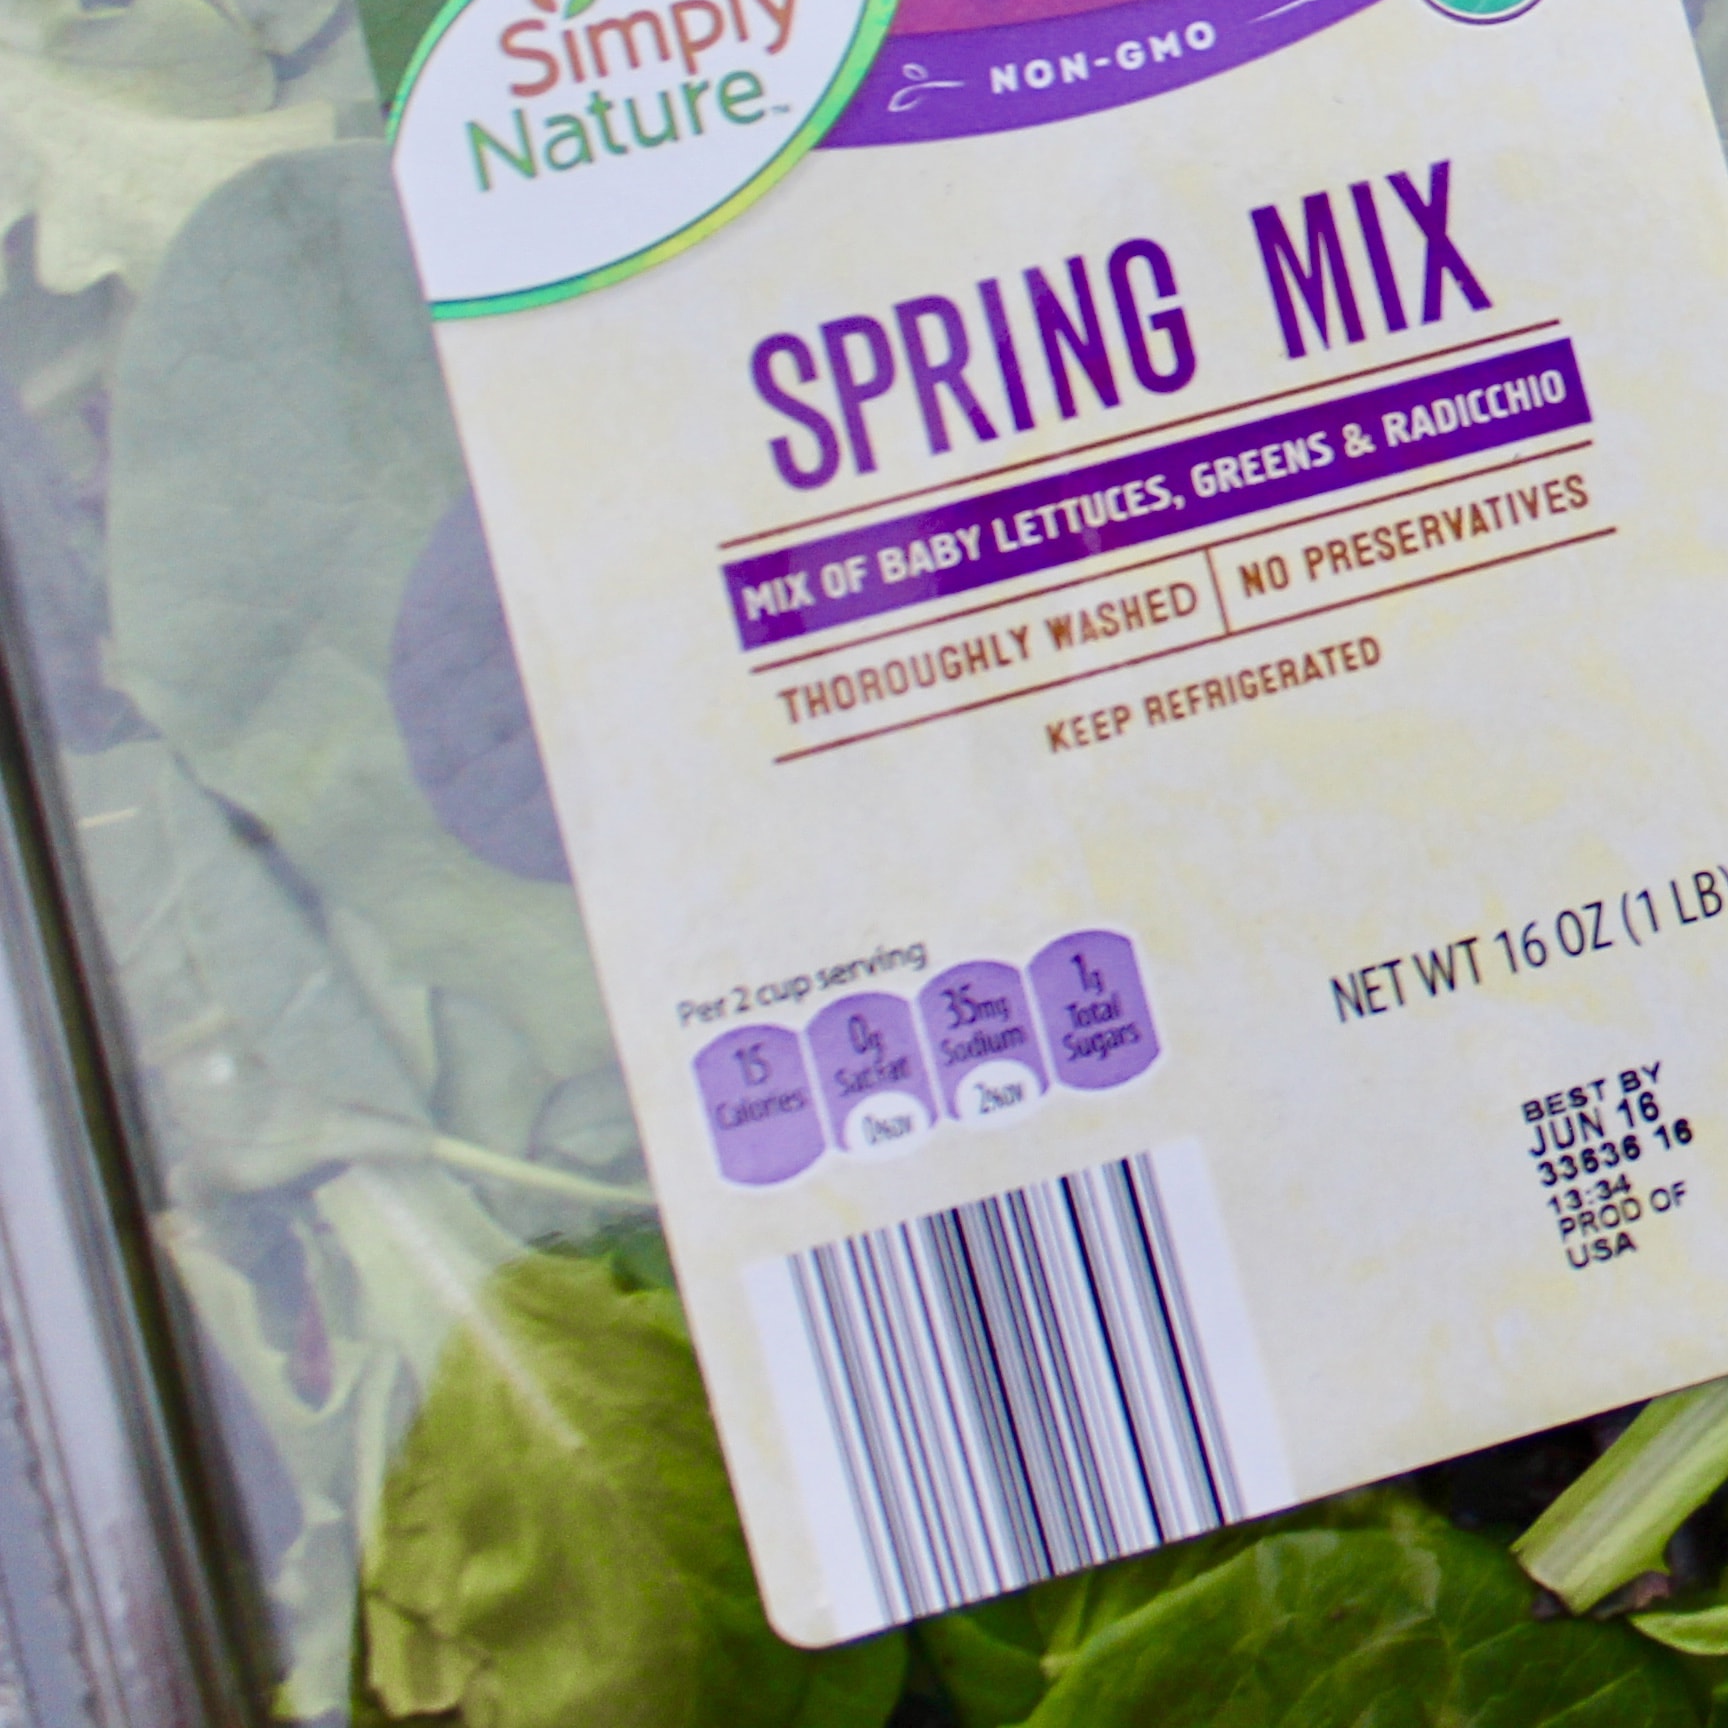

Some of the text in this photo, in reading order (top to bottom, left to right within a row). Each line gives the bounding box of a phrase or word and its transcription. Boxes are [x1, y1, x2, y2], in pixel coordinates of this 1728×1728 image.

[989, 20, 1217, 96] NON-GMO
[750, 159, 1492, 492] SPRING MIX
[742, 368, 1566, 622] MIX OF BABY LETTUCES, GREENS & RADICCHIO
[1237, 474, 1590, 598] NO PRESERVATIVES
[779, 581, 1198, 727] THOROUGHLY WASHED
[1045, 635, 1383, 755] KEEP REFRIGERATED
[676, 941, 929, 1029] Per 2 cup serving
[1329, 958, 1407, 1023] NET
[1412, 937, 1483, 998] WT
[1494, 922, 1548, 974] 16
[1555, 901, 1614, 957] OZ
[1620, 889, 1660, 947] (1
[1063, 1023, 1142, 1061] Sugars
[1065, 991, 1122, 1028] Total
[733, 1042, 770, 1085] 15
[941, 1026, 1027, 1065] Sodium
[1521, 1060, 1664, 1124] BEST BY
[1528, 1091, 1660, 1158] JUN 16
[1654, 1117, 1694, 1152] 16
[1546, 1173, 1632, 1216] 13:34
[1558, 1180, 1688, 1243] PROD OF
[1565, 1230, 1638, 1271] USA
